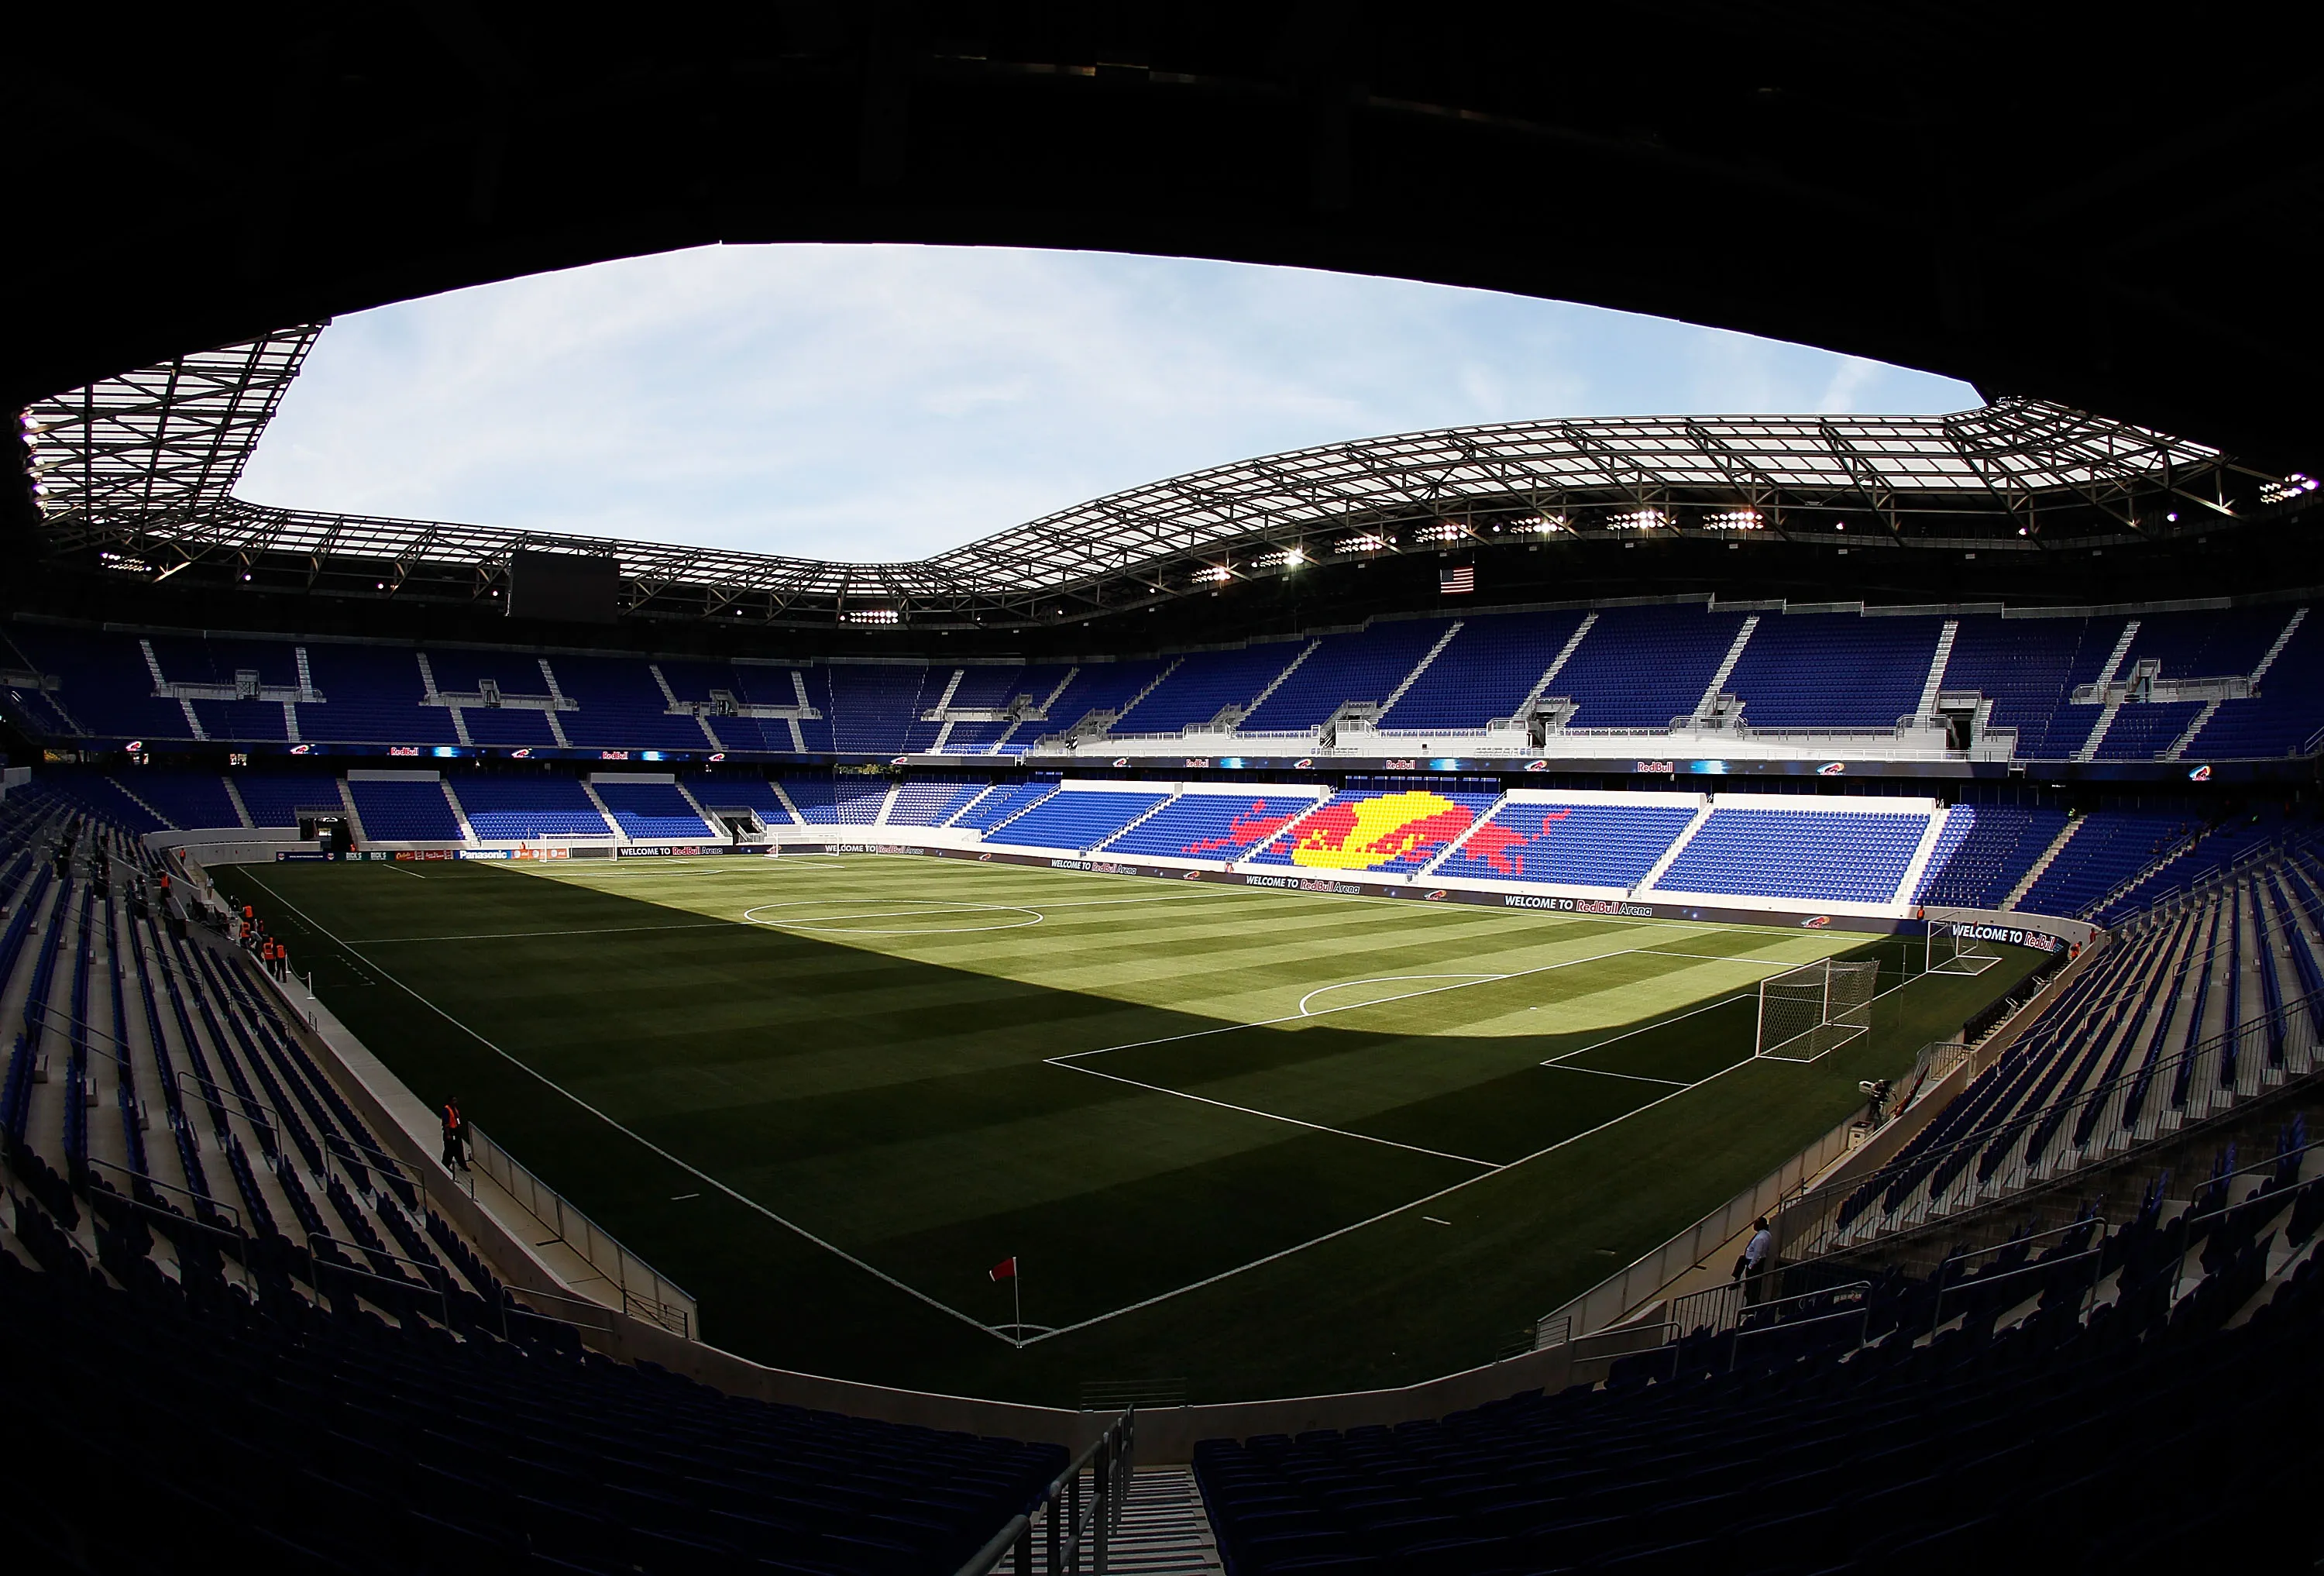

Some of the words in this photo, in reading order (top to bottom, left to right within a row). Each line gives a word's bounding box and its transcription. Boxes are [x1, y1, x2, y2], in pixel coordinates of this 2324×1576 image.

[459, 850, 507, 859] Panasonic
[1051, 859, 1081, 869] WELCOME
[1081, 862, 1091, 870] TO
[1246, 876, 1286, 886] WELCOME
[1287, 878, 1299, 889] TO
[1332, 882, 1360, 894] Arena
[1505, 896, 1556, 910] WELCOME
[1559, 900, 1573, 910] TO
[1619, 903, 1652, 916] Arena
[1952, 924, 2007, 941] WELCOME
[2009, 931, 2023, 943] TO
